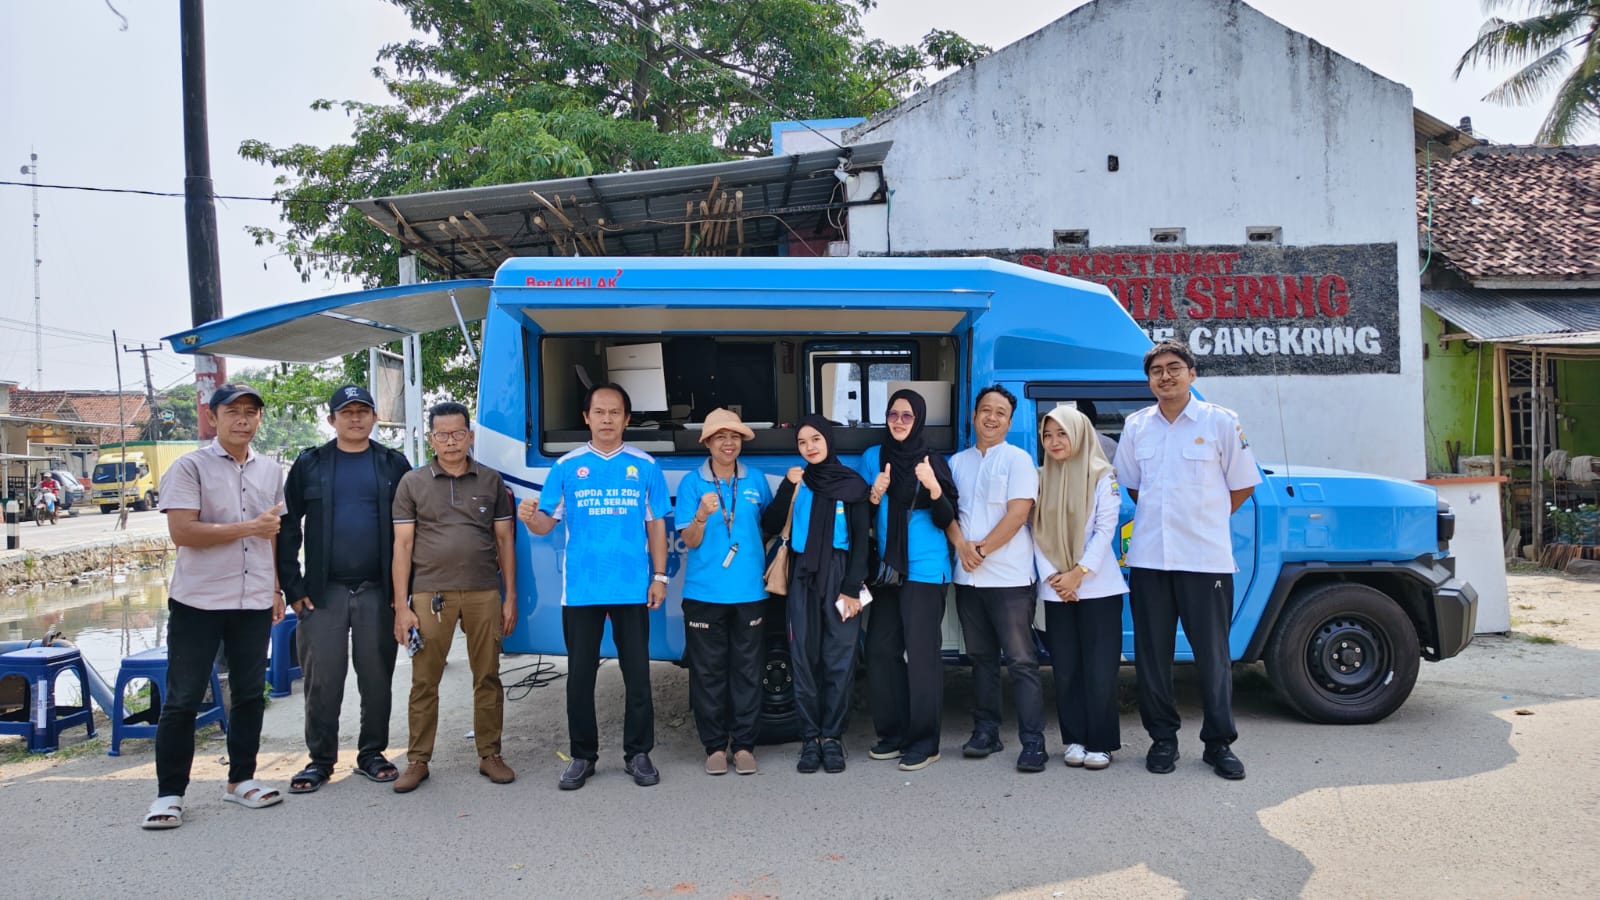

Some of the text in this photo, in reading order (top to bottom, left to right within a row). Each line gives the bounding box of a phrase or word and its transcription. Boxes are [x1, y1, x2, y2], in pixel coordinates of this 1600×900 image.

[1021, 252, 1240, 276] SEKRETARIAT
[1083, 273, 1350, 321] OTA SERANG
[1189, 325, 1382, 357] CANGKRING
[577, 498, 601, 508] KOTA
